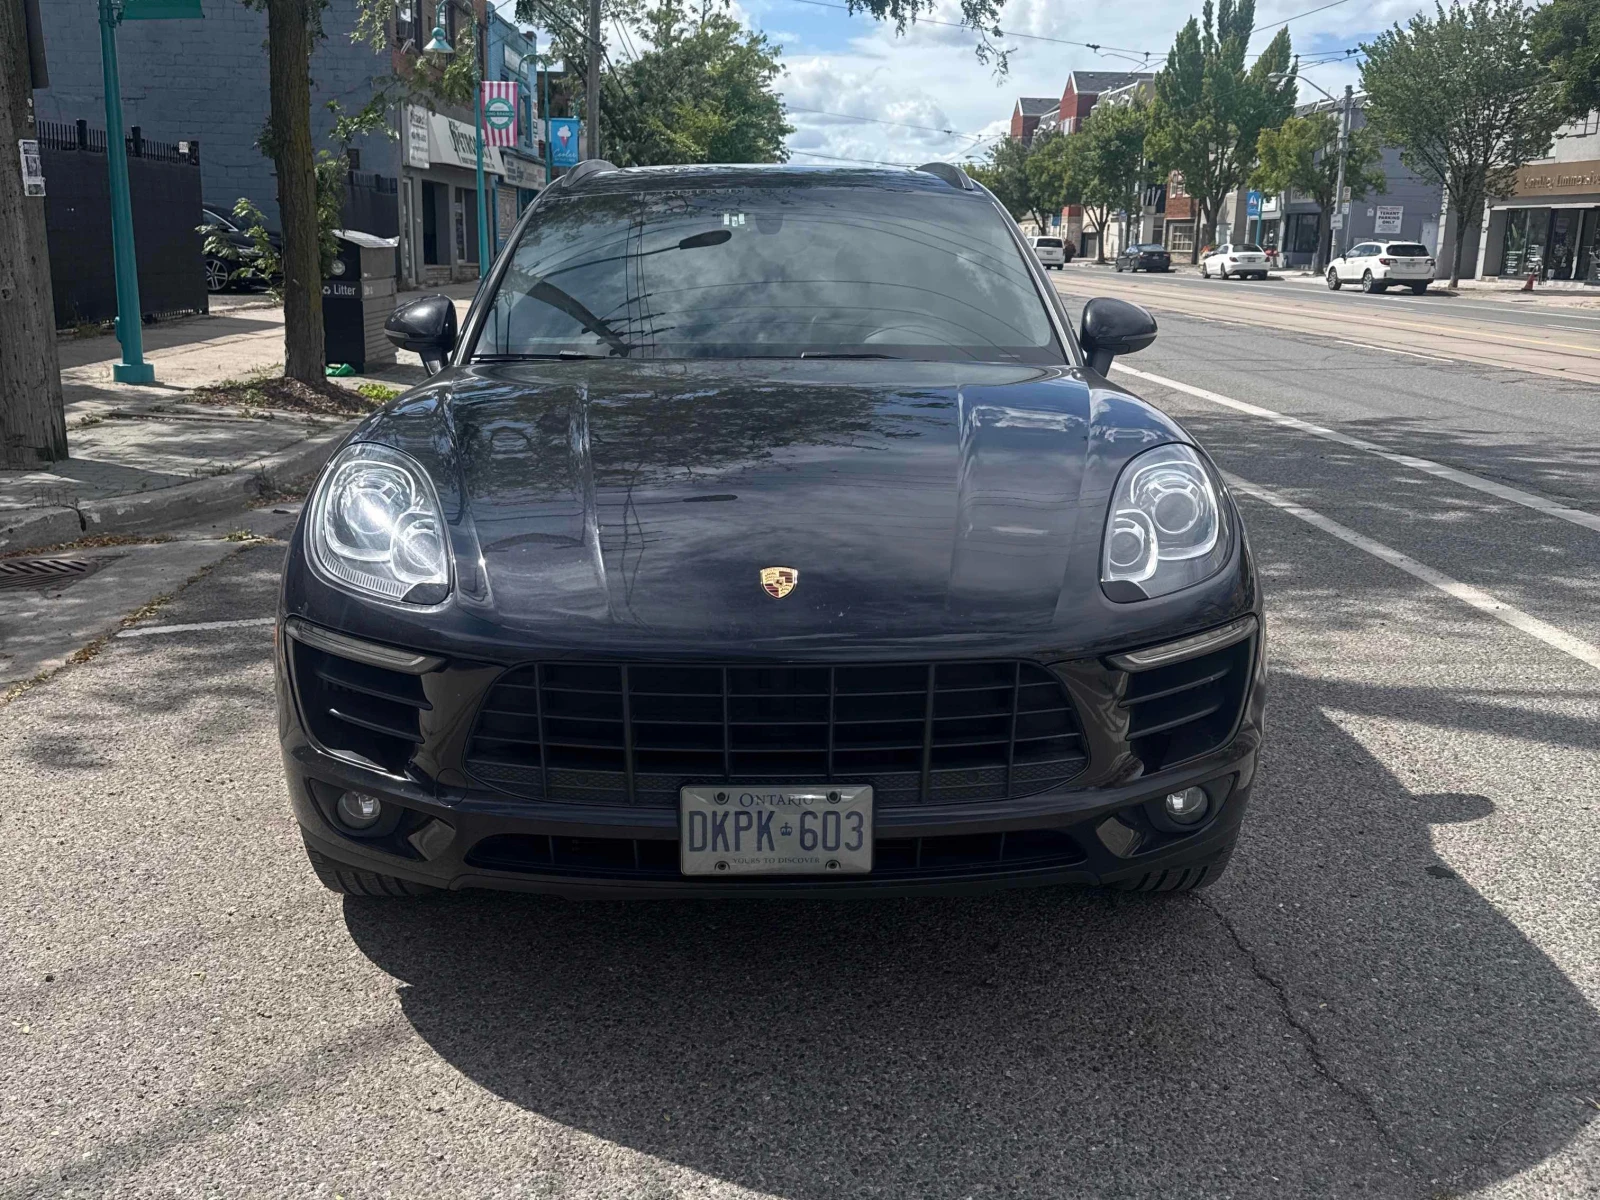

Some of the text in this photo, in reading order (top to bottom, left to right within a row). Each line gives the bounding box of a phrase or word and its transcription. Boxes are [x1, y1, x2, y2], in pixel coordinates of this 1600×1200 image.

[333, 284, 356, 296] Litter
[739, 792, 814, 808] ONTARIO
[688, 810, 864, 852] DKPK 603
